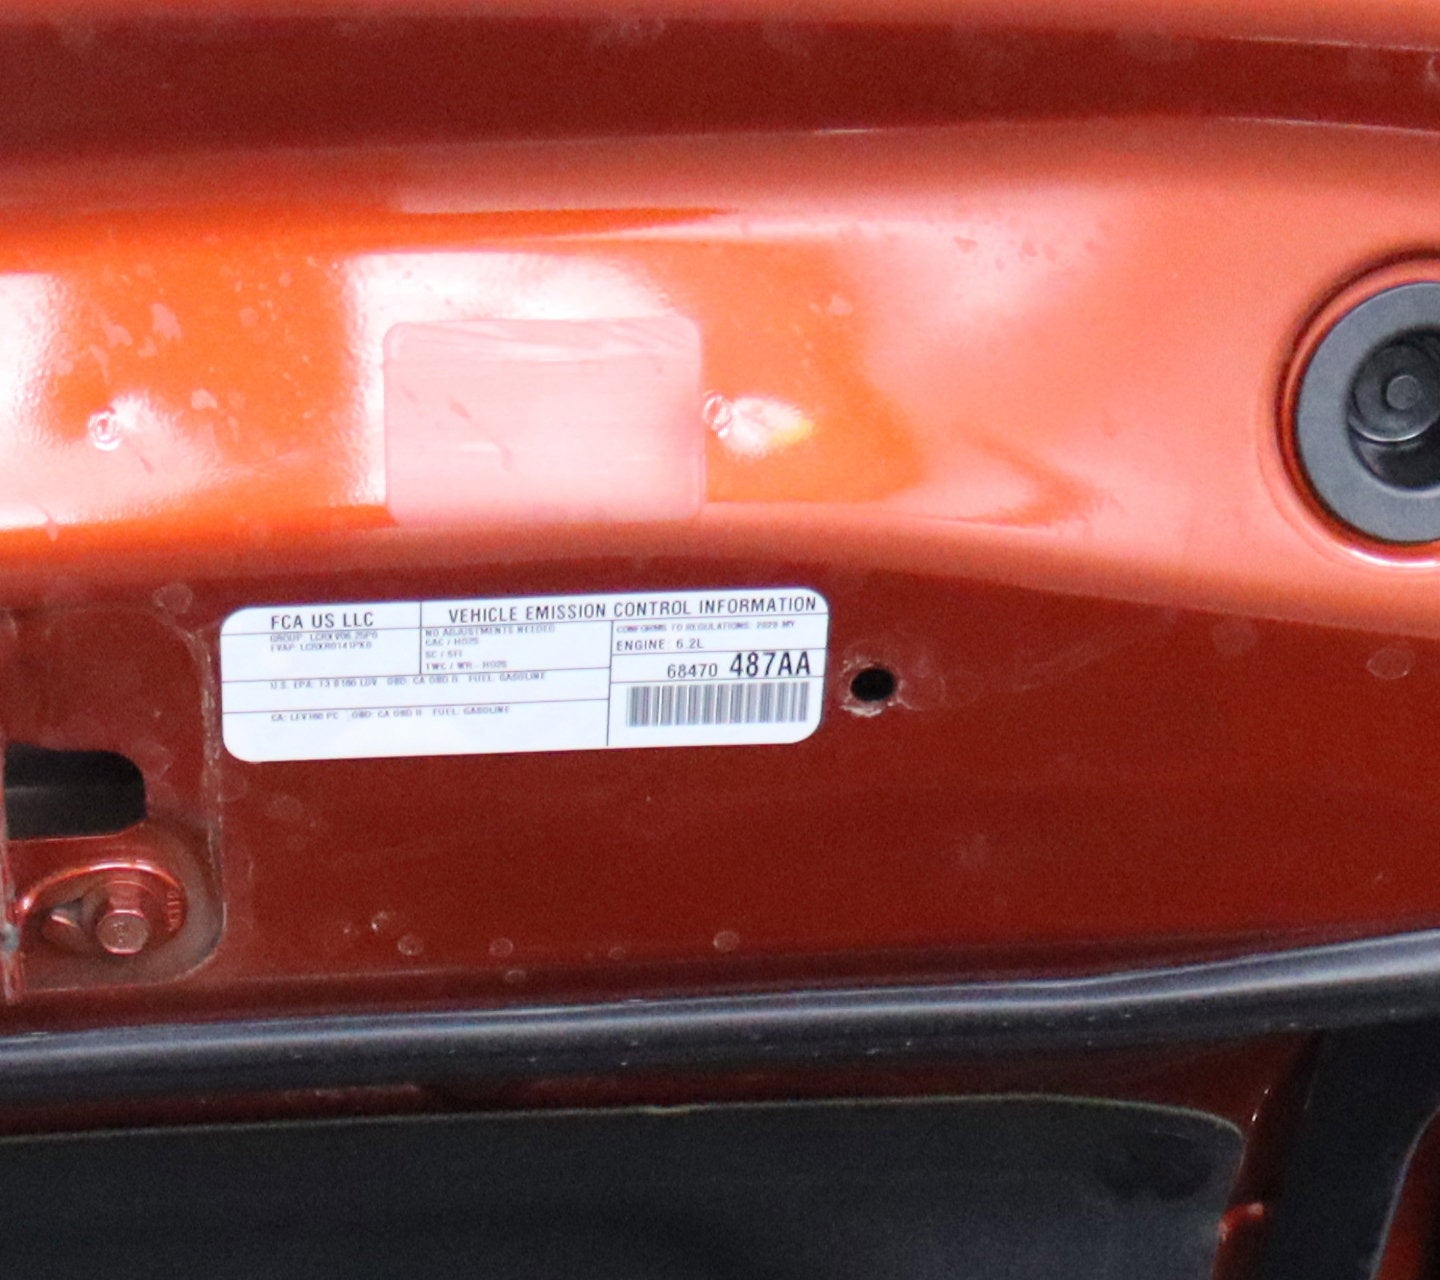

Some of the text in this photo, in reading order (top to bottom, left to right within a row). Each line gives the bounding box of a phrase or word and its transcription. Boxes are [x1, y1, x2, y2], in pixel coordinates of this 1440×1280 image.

[271, 612, 374, 630] FCA US LLC
[449, 597, 816, 623] VEHICLE EMISSION CONTROL INFORMATION
[676, 638, 704, 649] 6.2L
[667, 651, 811, 679] 68470 487AA
